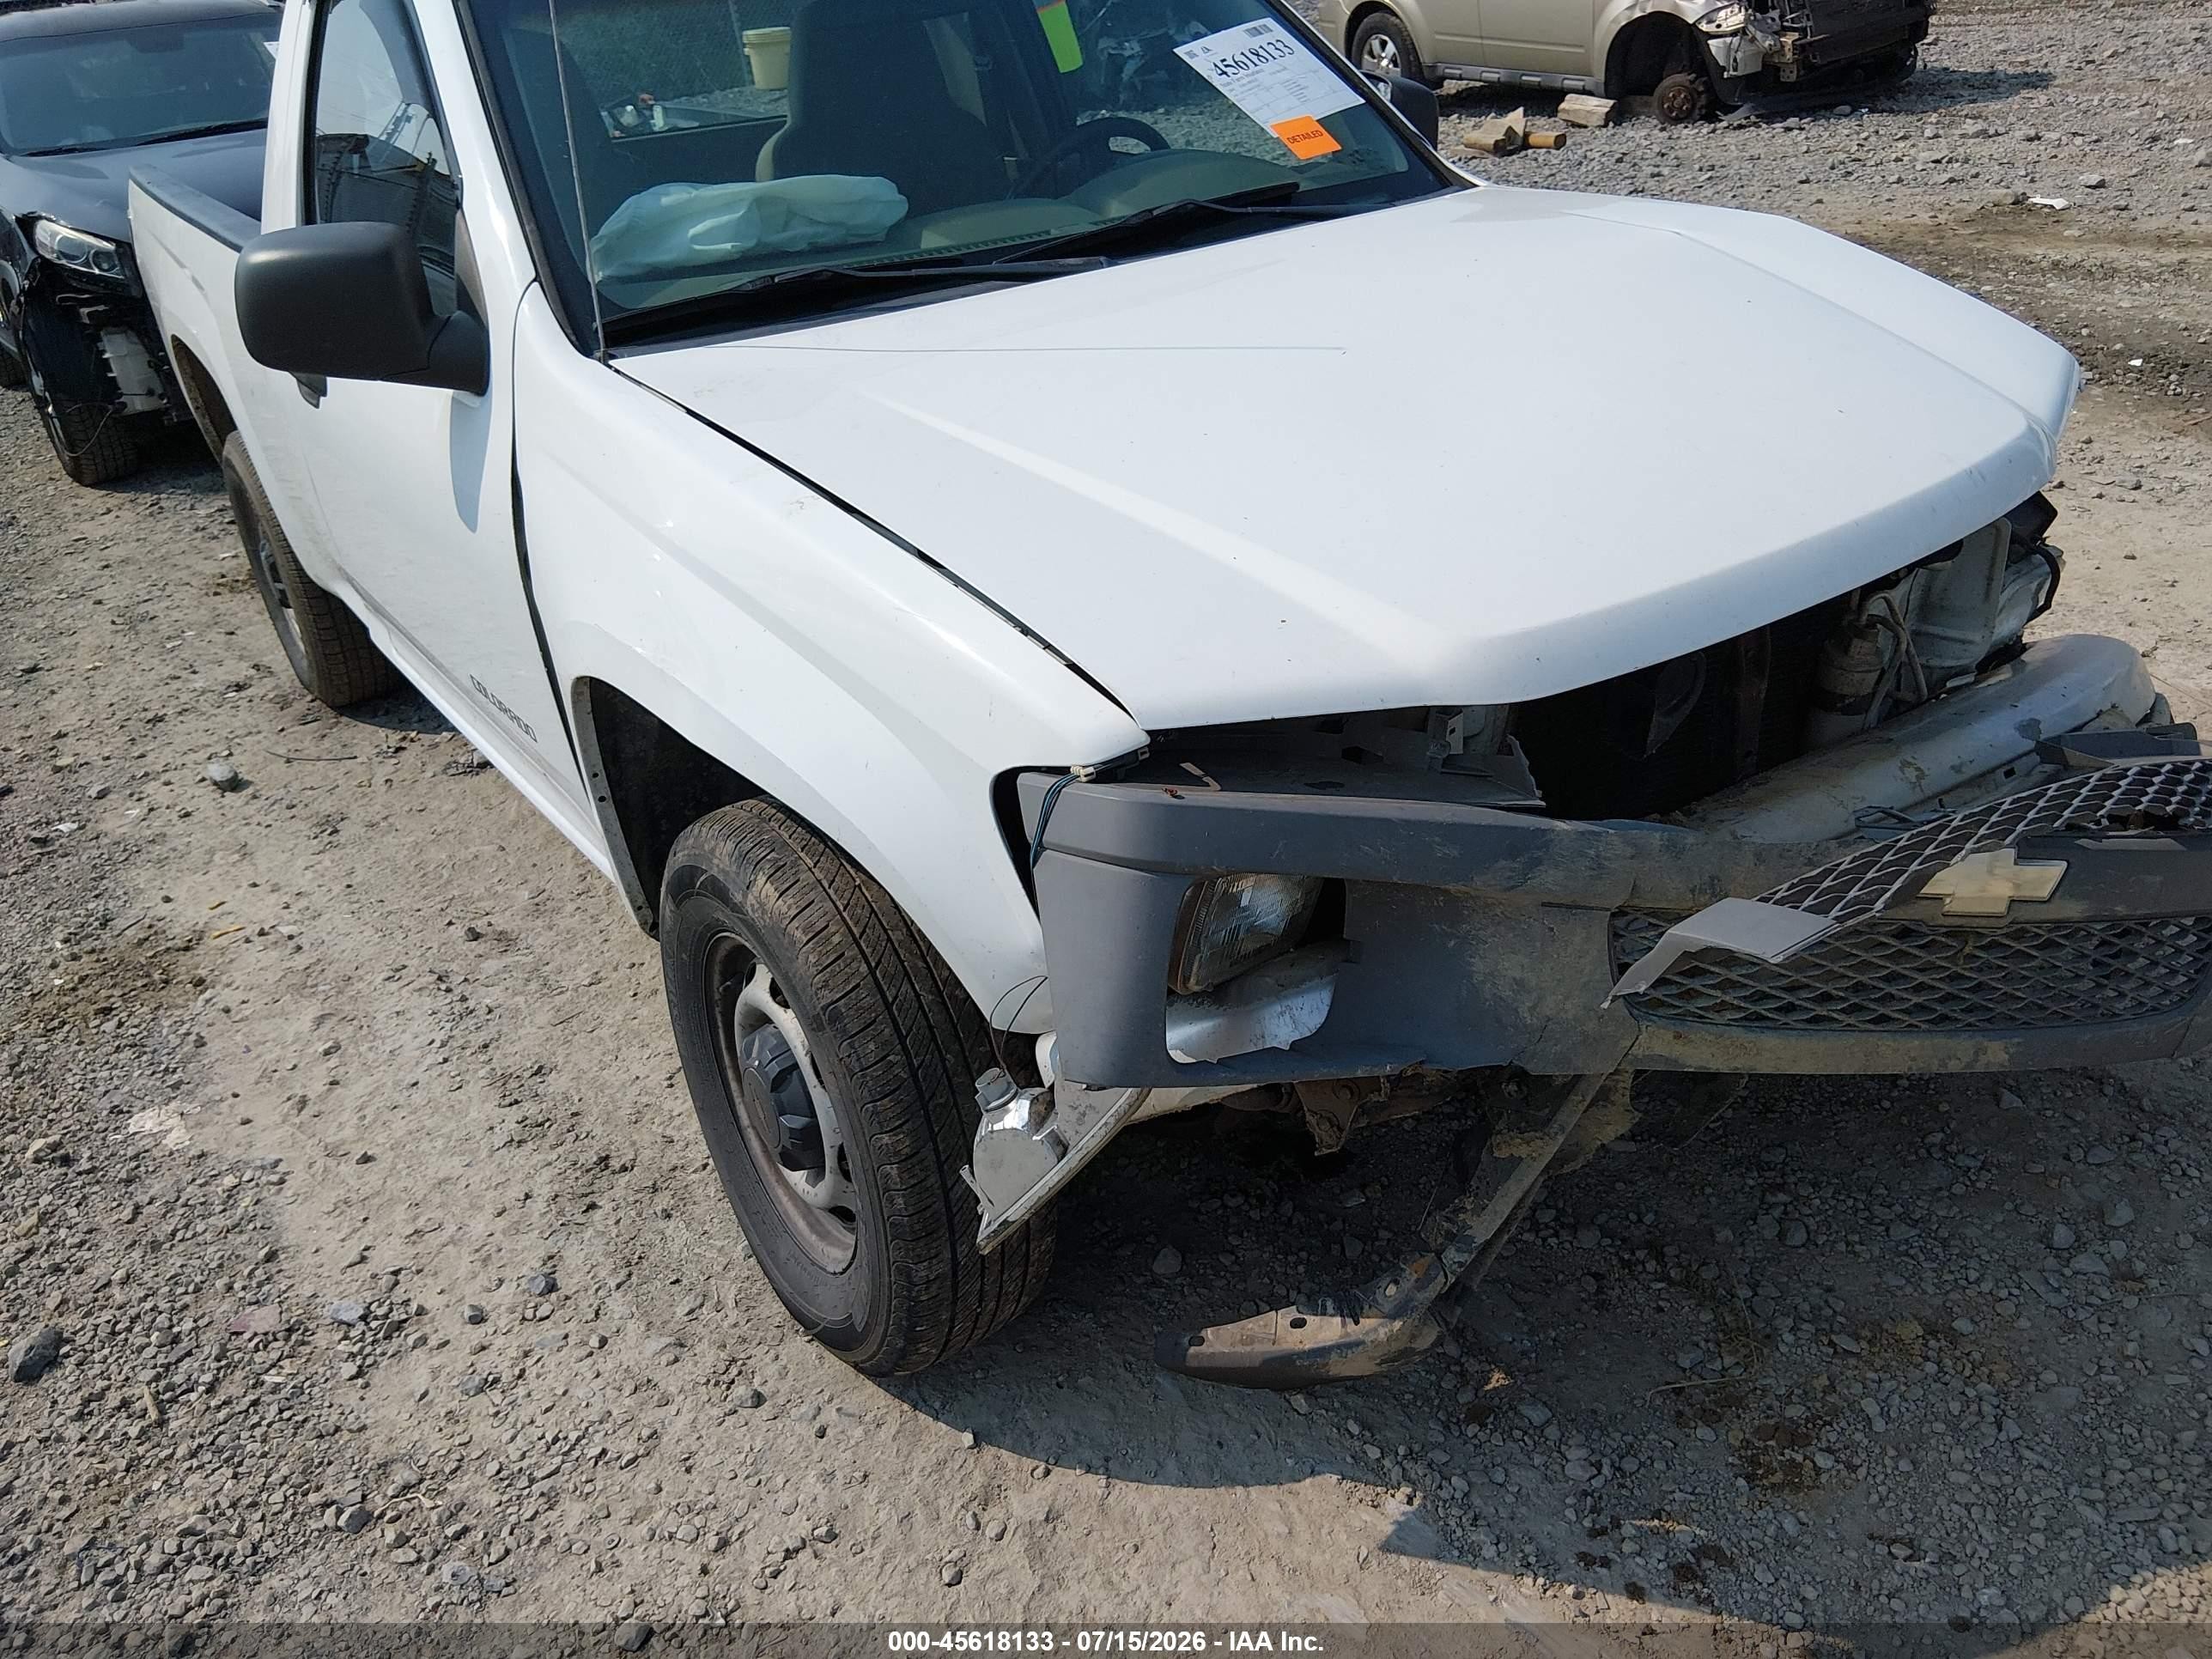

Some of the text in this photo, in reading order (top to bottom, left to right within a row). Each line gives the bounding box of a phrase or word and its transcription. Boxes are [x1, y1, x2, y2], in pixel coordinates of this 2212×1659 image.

[1212, 39, 1295, 79] 45618133
[1286, 130, 1323, 144] DETAILED
[469, 673, 538, 744] COLORADO
